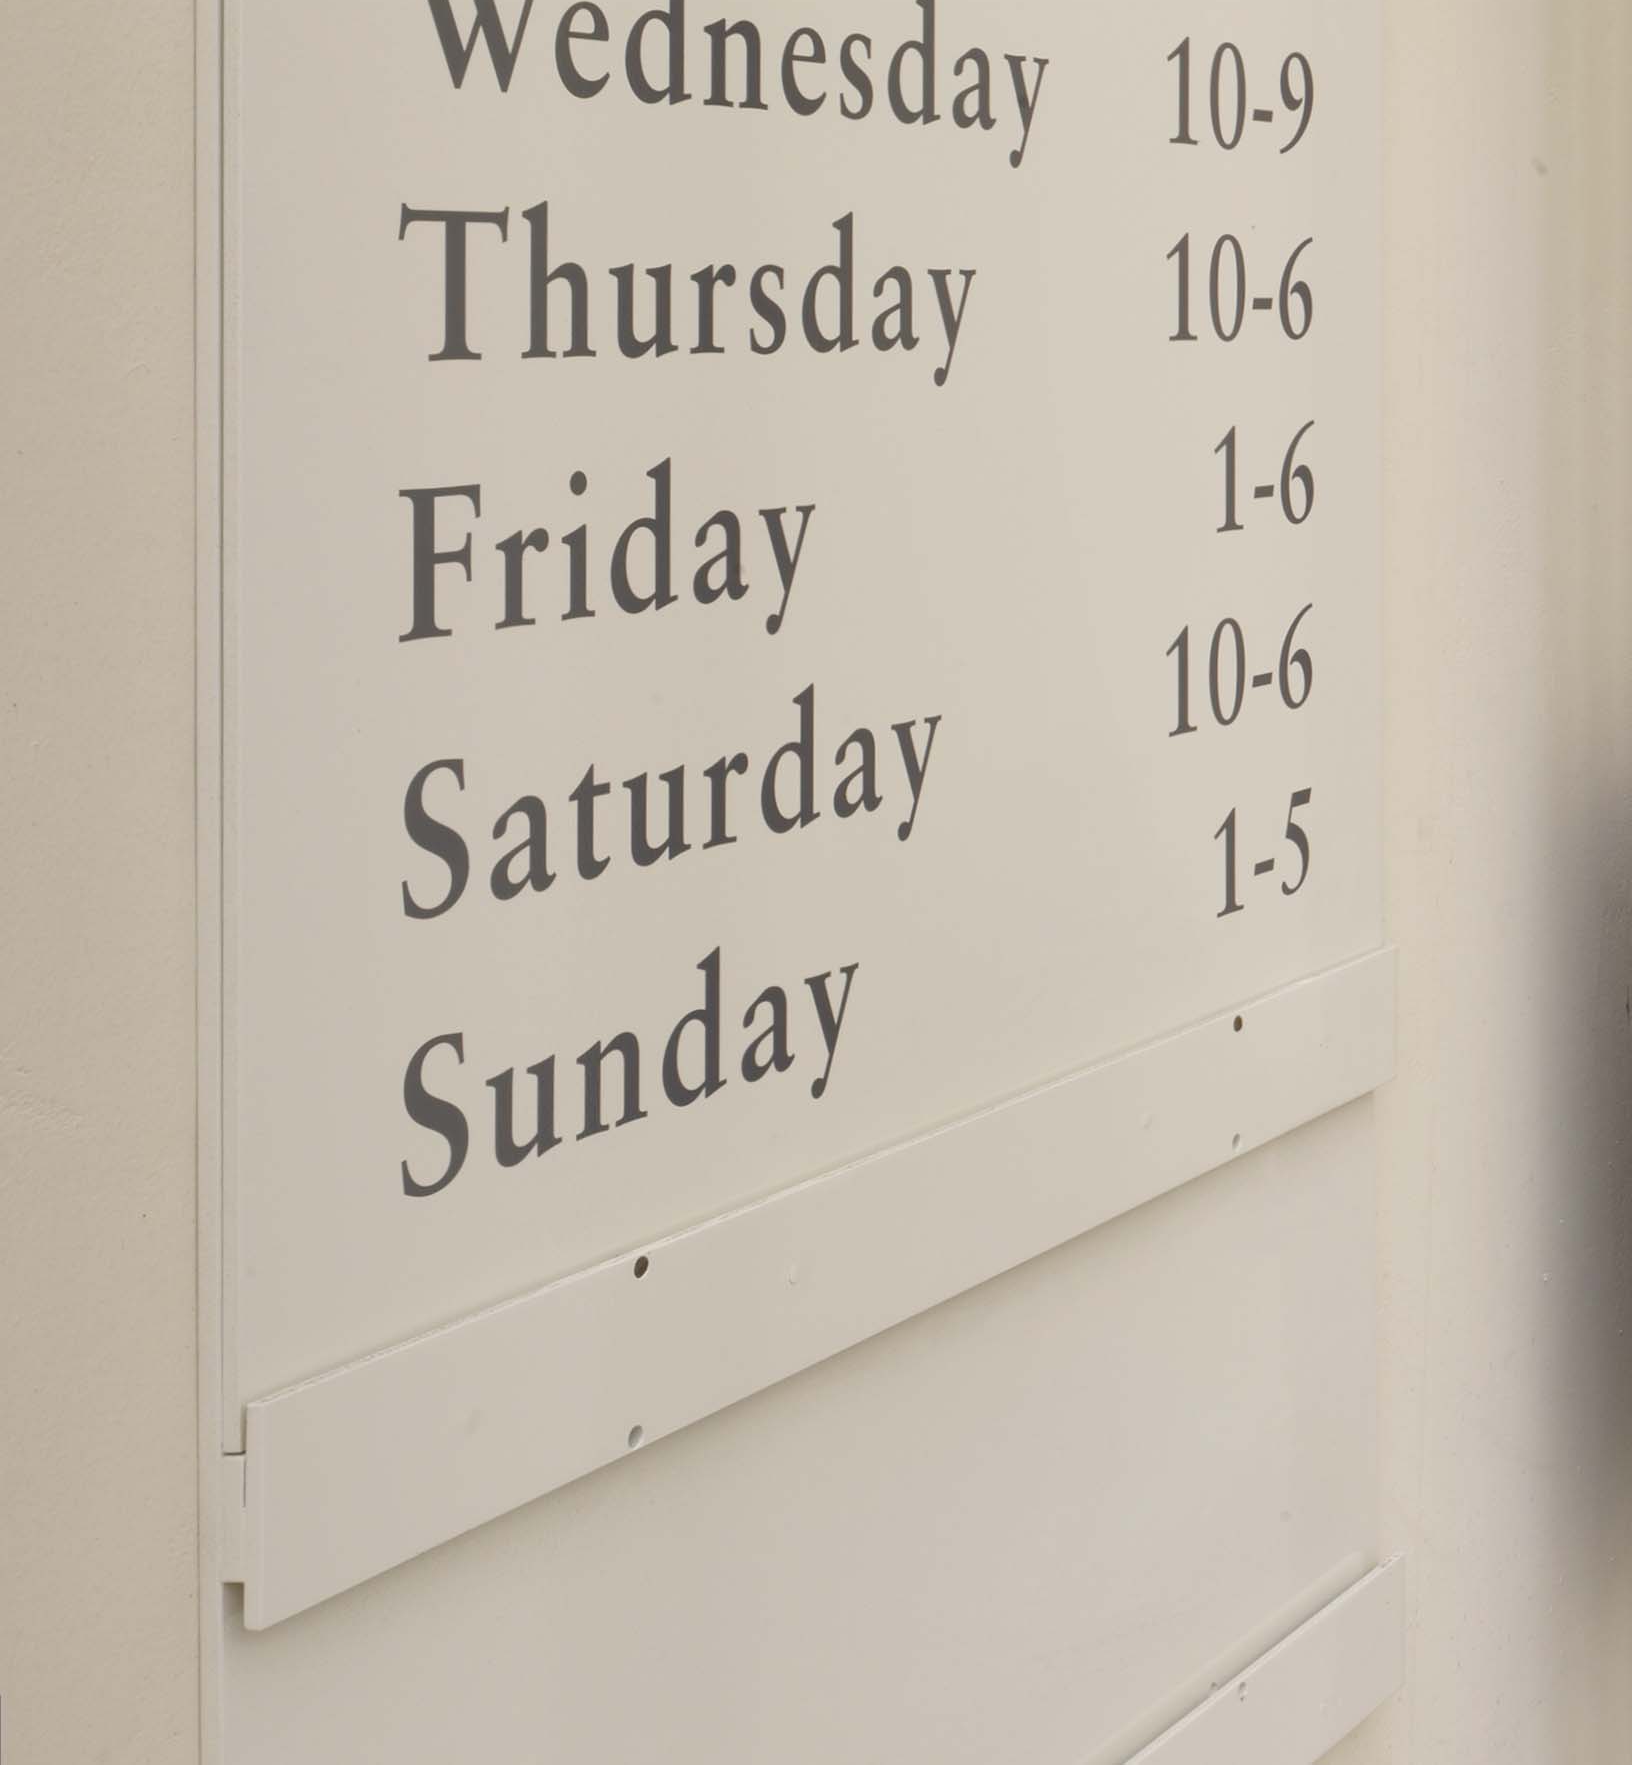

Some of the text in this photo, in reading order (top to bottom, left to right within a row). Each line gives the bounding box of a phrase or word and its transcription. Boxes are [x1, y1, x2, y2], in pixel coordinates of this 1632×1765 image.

[1165, 35, 1315, 156] 10-9
[397, 199, 1315, 388] Thursday 10-6
[397, 418, 1316, 644] Friday 1-6
[400, 601, 1314, 921] Saturday 10-6
[400, 786, 1313, 1199] Sunday 1-5
